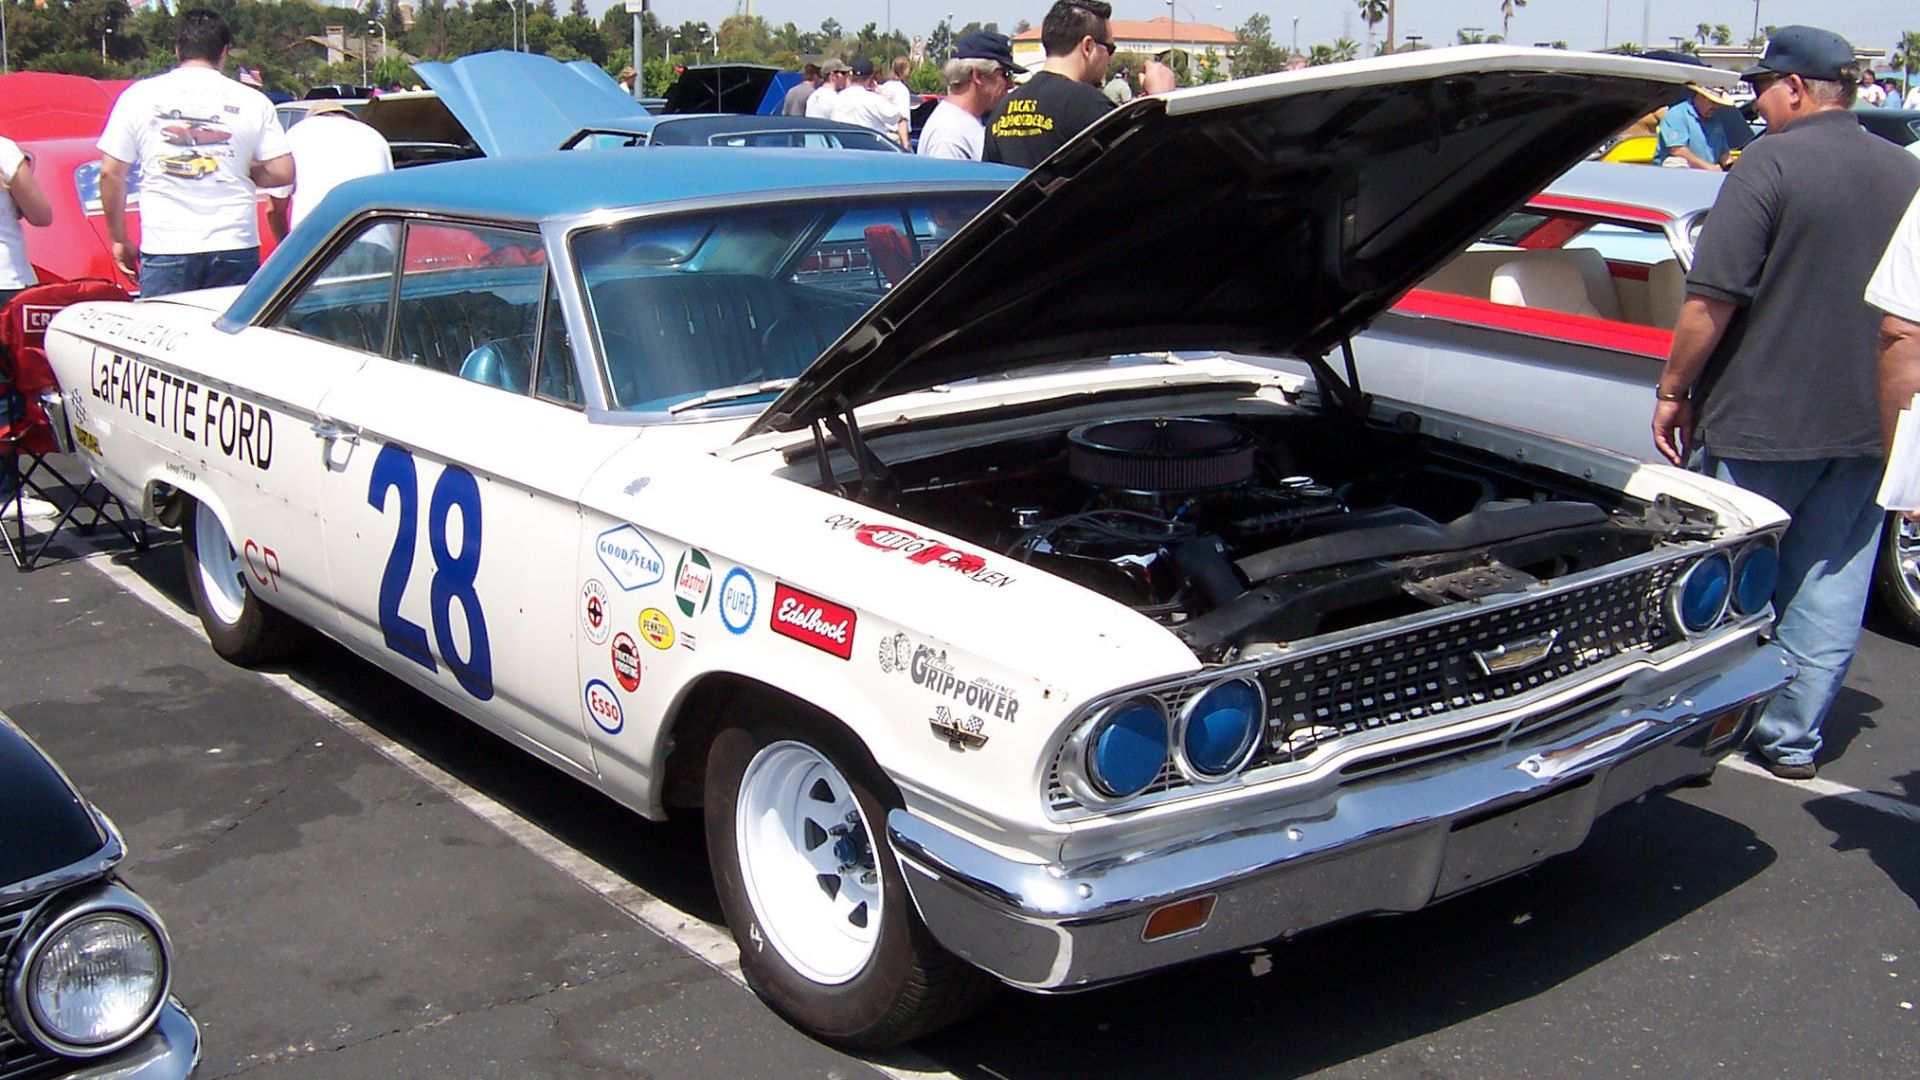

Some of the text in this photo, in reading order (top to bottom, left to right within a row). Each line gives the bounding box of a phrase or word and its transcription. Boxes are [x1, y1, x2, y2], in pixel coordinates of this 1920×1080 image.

[31, 312, 54, 326] CR
[91, 346, 273, 471] LaFAYETTE FORD
[367, 442, 494, 701] 28
[680, 563, 709, 595] Castrol
[726, 587, 751, 616] PURE
[778, 597, 848, 644] Edelbrock
[911, 645, 1019, 723] GRIPPOWER
[591, 690, 619, 722] ESSO
